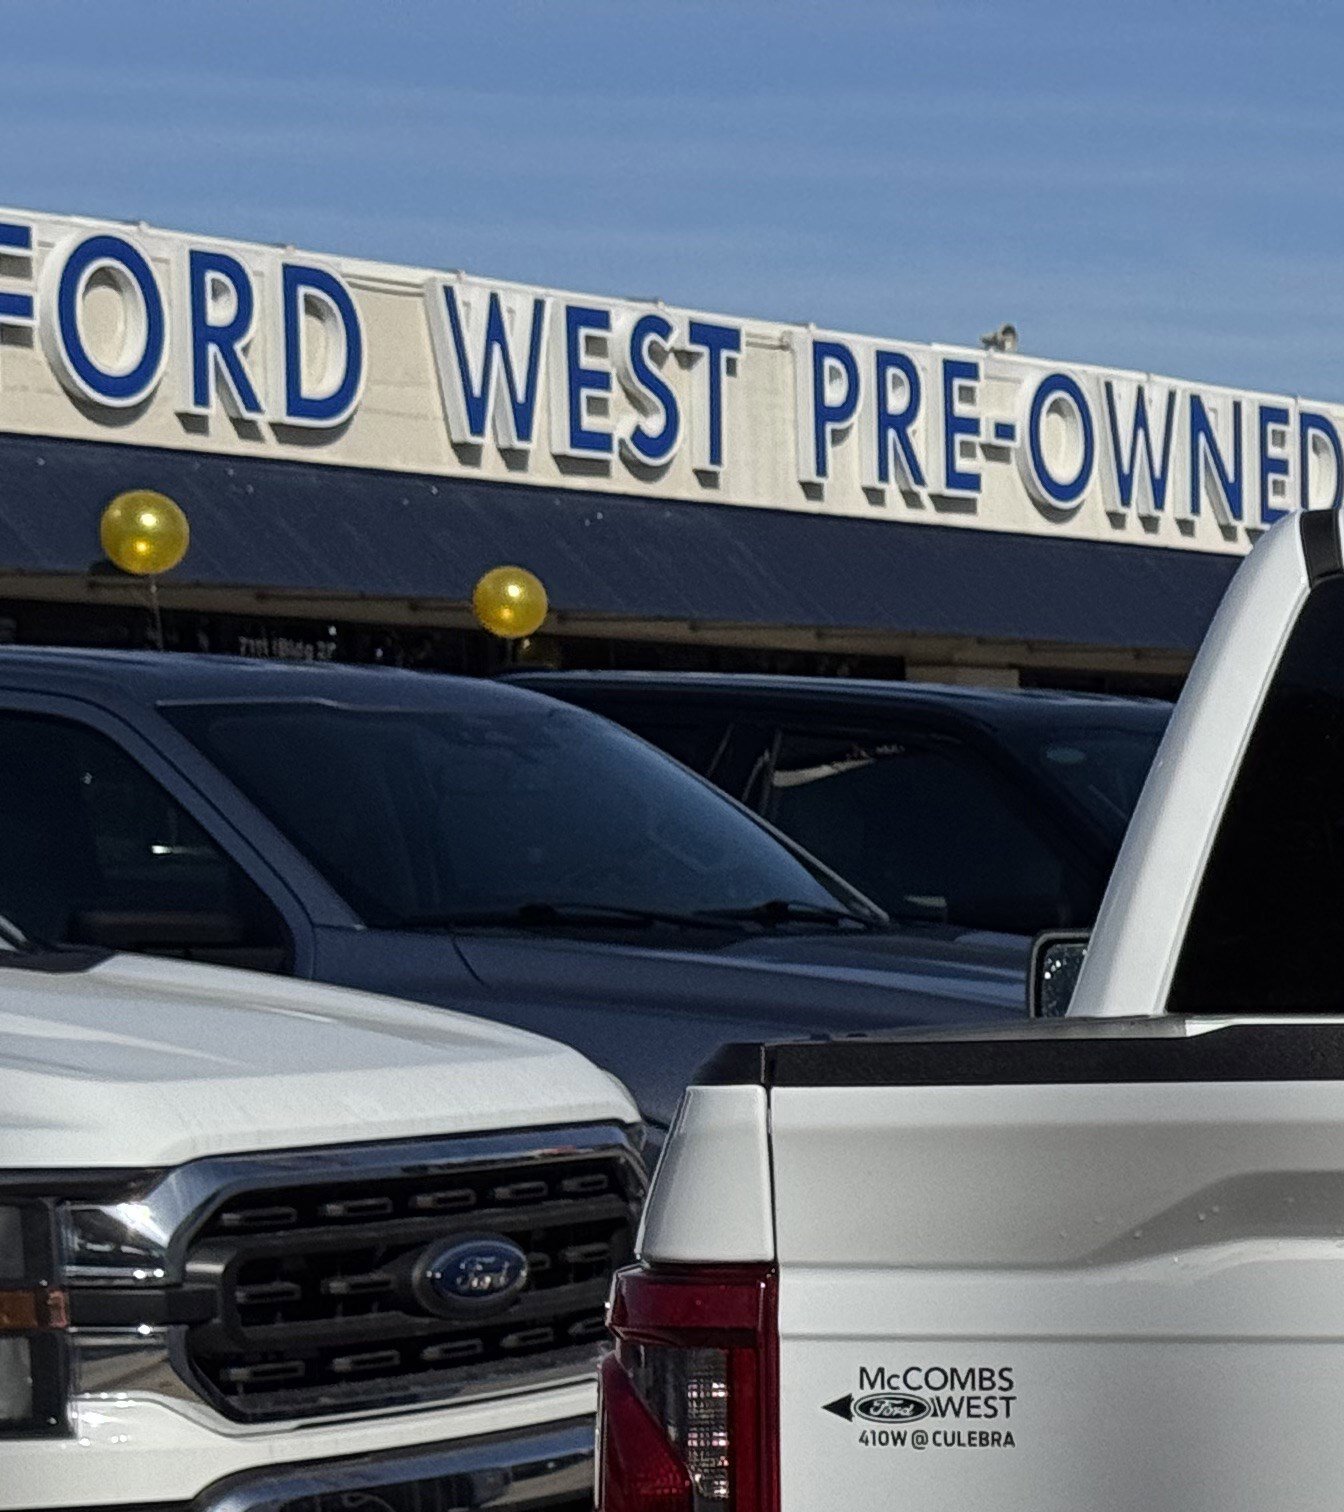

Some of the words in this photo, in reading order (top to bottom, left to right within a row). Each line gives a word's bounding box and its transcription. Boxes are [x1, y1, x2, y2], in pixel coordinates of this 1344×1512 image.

[442, 284, 742, 466] WEST
[811, 340, 1344, 523] PRE-OWNED
[858, 1366, 1015, 1392] McCOMBS
[868, 1399, 916, 1418] Ford
[933, 1395, 1018, 1419] WEST
